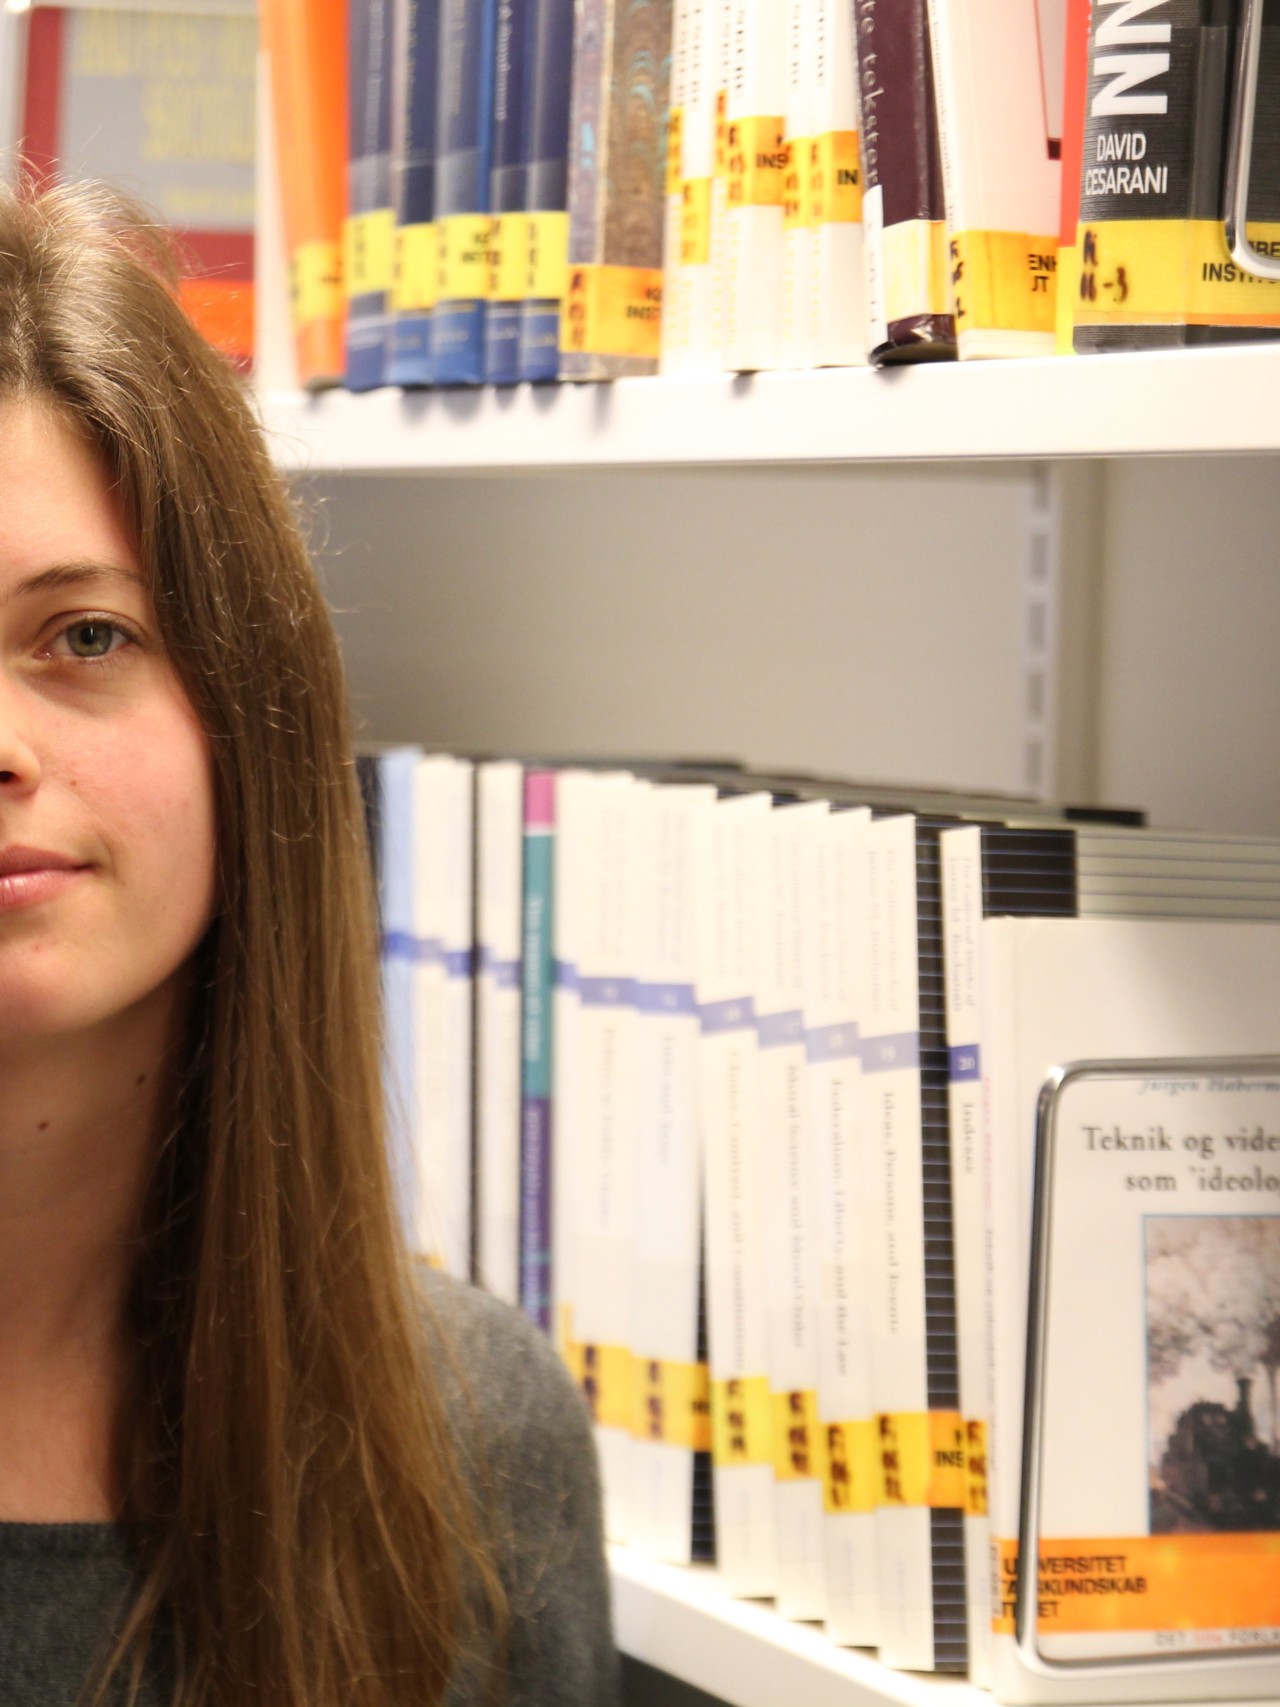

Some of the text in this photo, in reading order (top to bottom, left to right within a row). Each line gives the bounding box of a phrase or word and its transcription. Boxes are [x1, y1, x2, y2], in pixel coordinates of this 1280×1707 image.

[1096, 133, 1146, 161] DAVID
[1083, 166, 1168, 195] CESARANI
[963, 1101, 977, 1175] Indexes
[1081, 1125, 1174, 1151] Teknik
[1184, 1135, 1216, 1160] og
[1126, 1174, 1177, 1192] som
